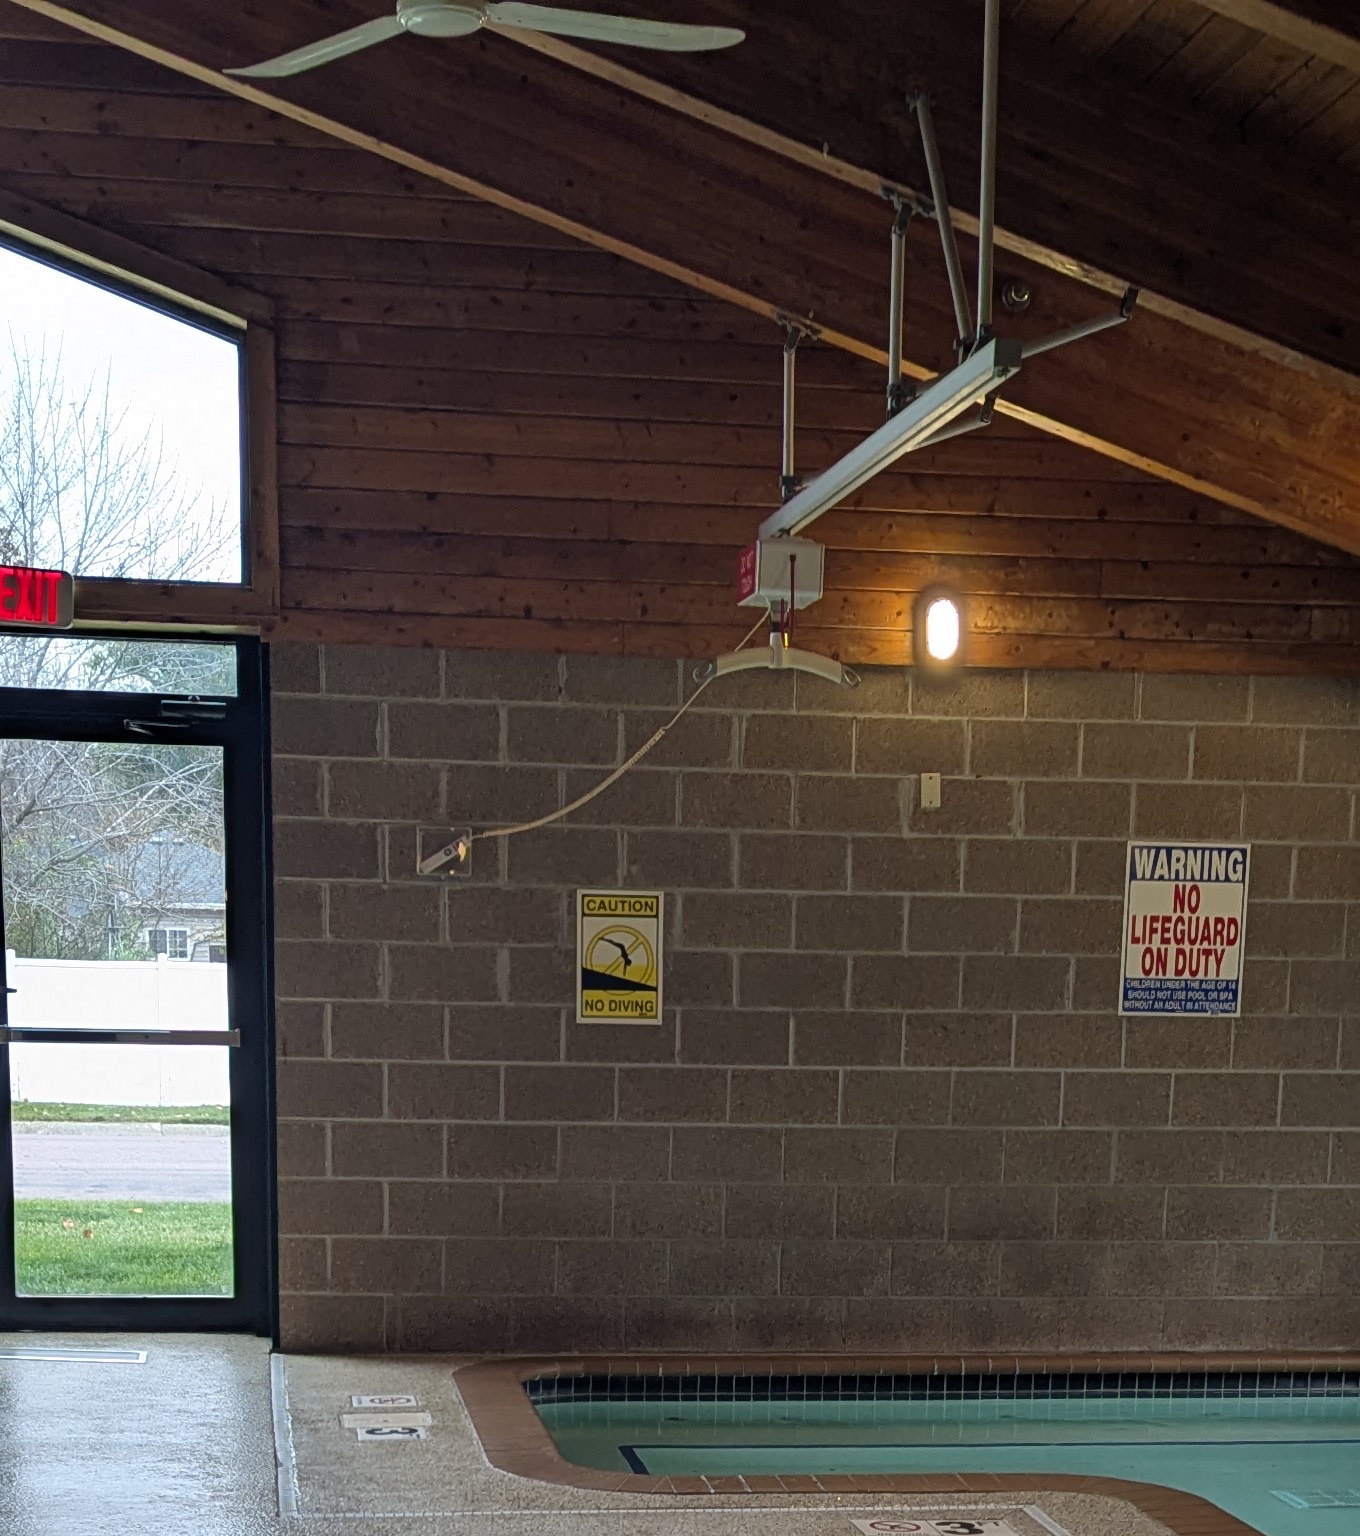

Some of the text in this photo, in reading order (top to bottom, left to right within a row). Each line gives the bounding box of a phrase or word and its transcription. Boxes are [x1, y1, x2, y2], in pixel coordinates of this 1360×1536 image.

[1134, 848, 1243, 882] WARNING
[1173, 883, 1201, 914] NO
[586, 899, 654, 912] CAUTION
[1130, 915, 1239, 946] LIFEGUARD
[1141, 947, 1226, 978] ON DUTY
[1126, 980, 1160, 989] CHILDREN
[1162, 980, 1186, 989] UNDER
[1187, 980, 1199, 989] THE
[1201, 981, 1215, 989] AGE
[1217, 981, 1226, 989] OF
[1128, 990, 1233, 1000] SHOULD NOT USE POOL OR SPA
[585, 1000, 654, 1012] NO DIVING
[1124, 1001, 1153, 1009] WITHOUT
[1154, 1001, 1163, 1009] AN
[1164, 1001, 1186, 1010] ADULT
[1194, 1002, 1236, 1010] ATTENDANCE
[935, 1521, 984, 1535] 3
